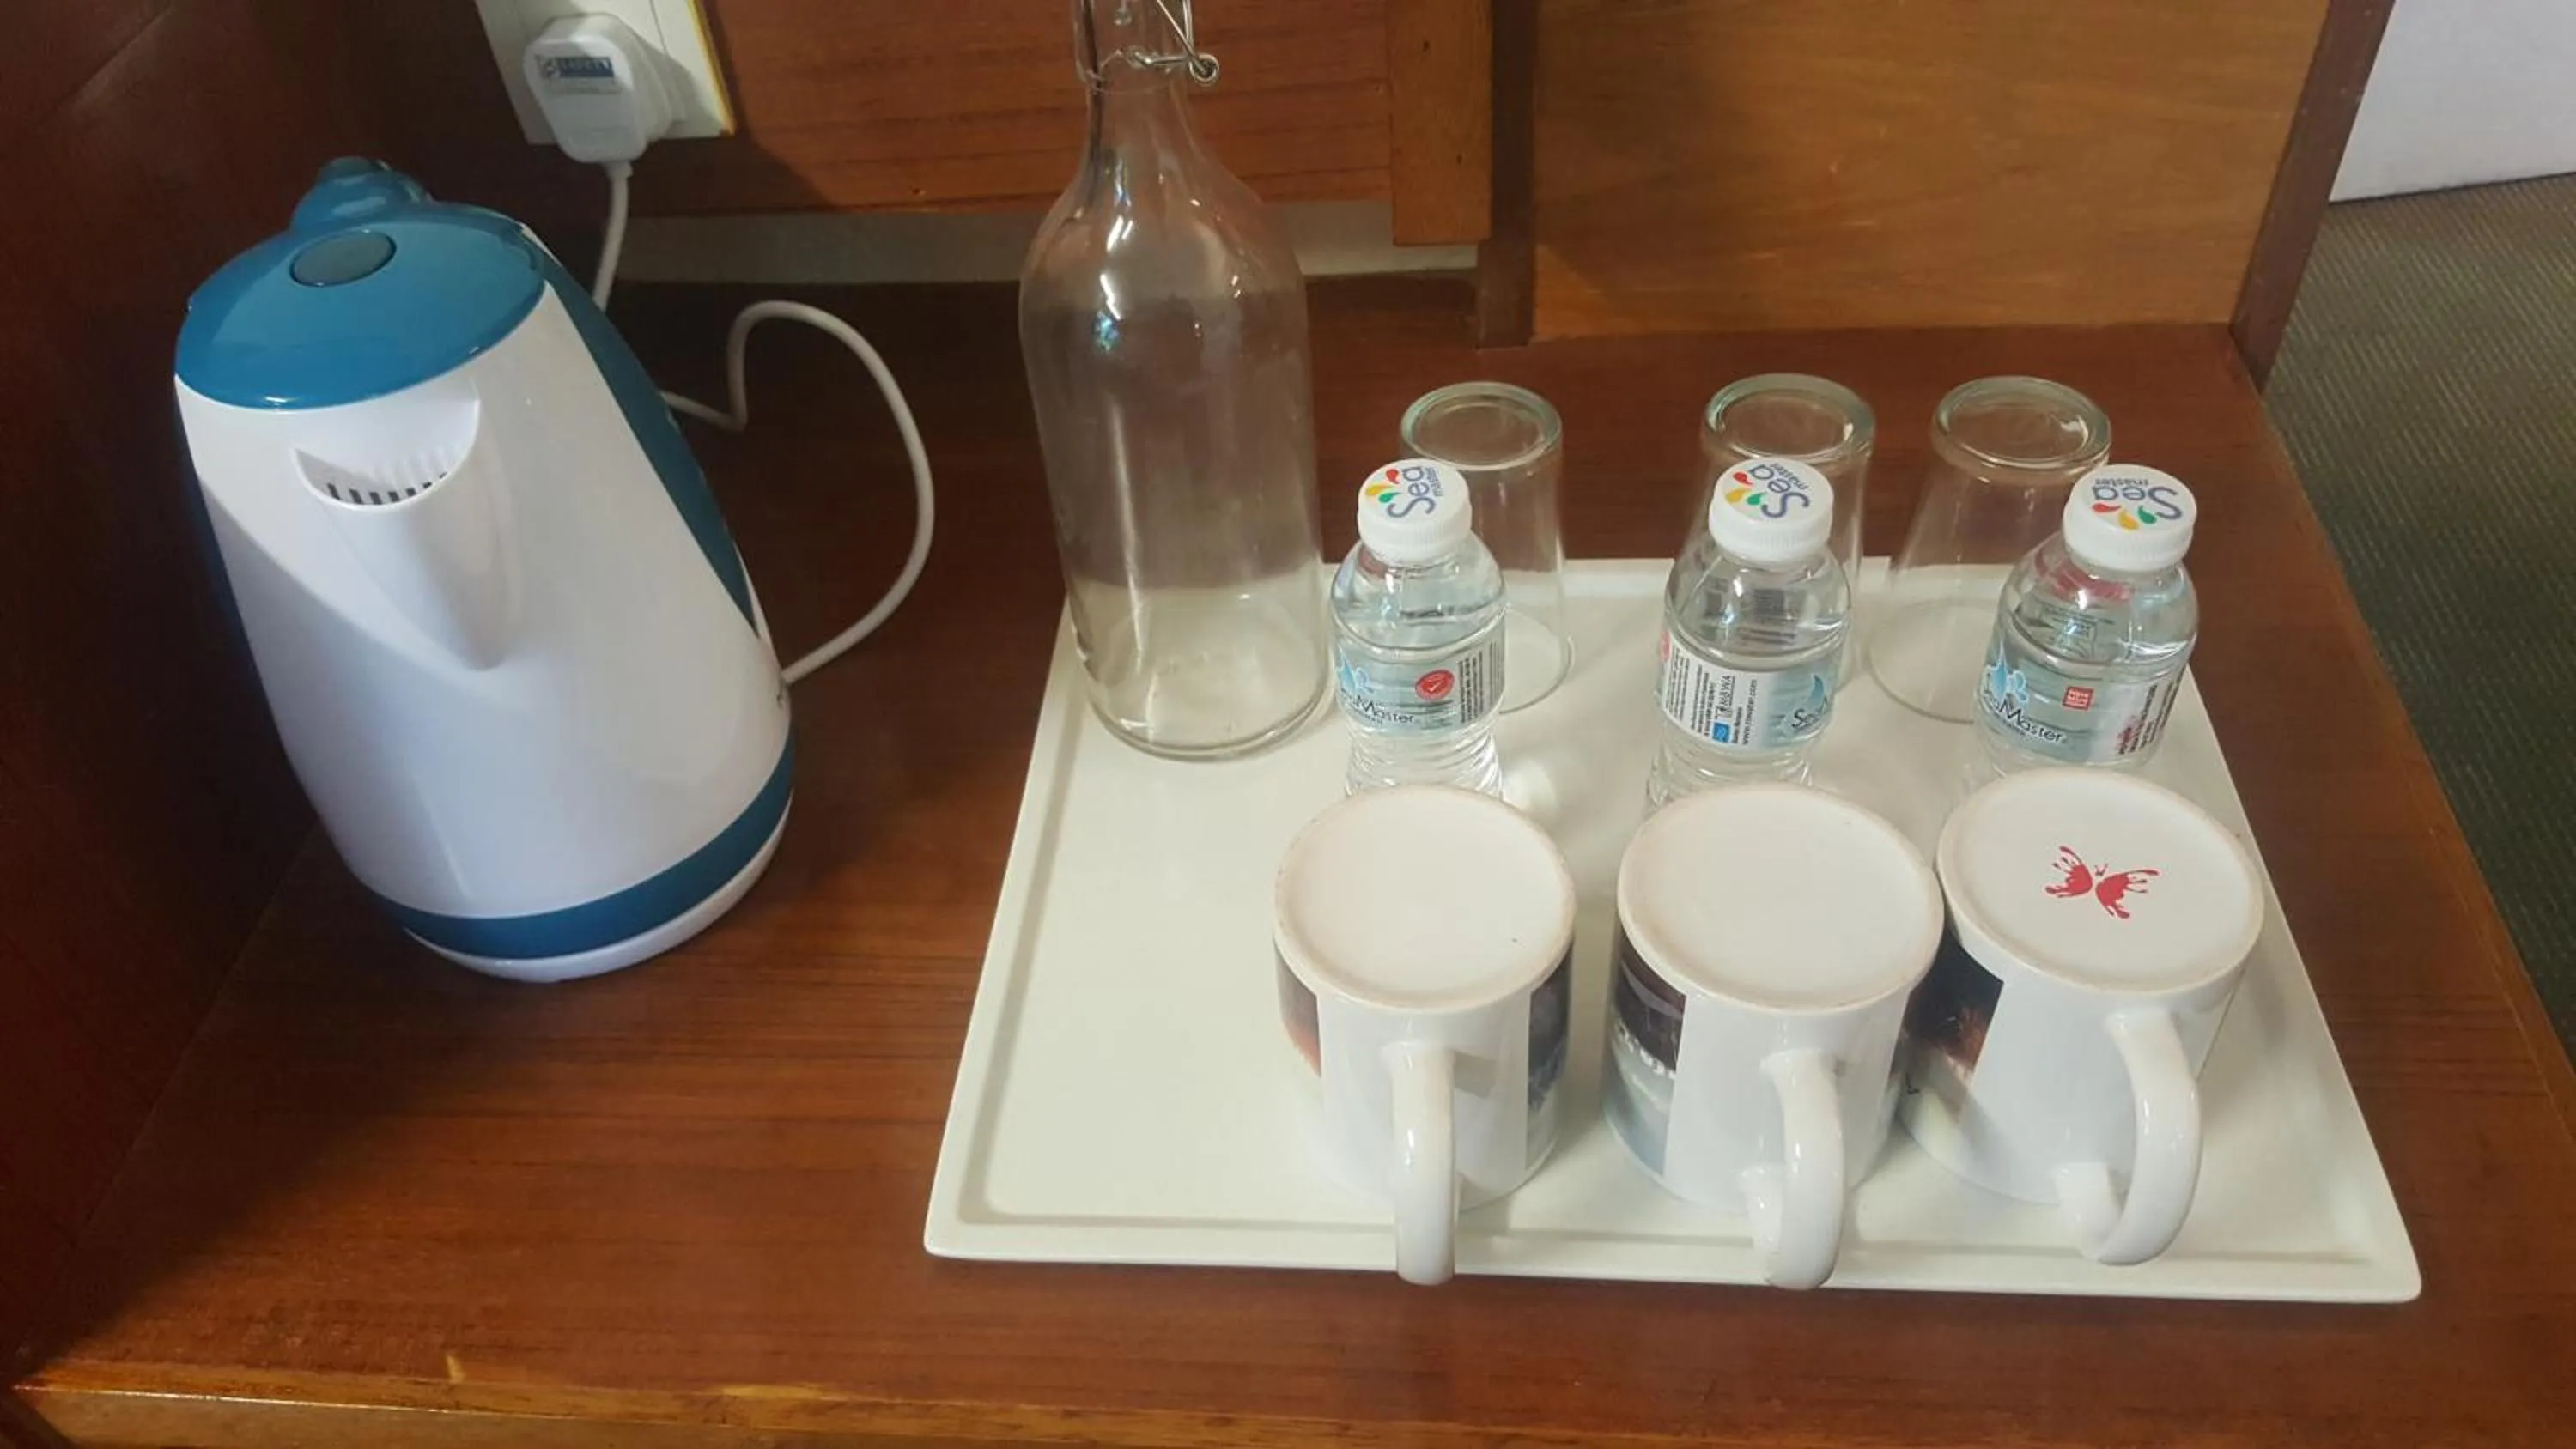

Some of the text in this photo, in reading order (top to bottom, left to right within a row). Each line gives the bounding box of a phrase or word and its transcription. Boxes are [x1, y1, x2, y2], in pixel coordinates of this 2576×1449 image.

[1386, 465, 1437, 518] Sea
[1748, 464, 1810, 518] Sea
[2092, 485, 2183, 520] Sea
